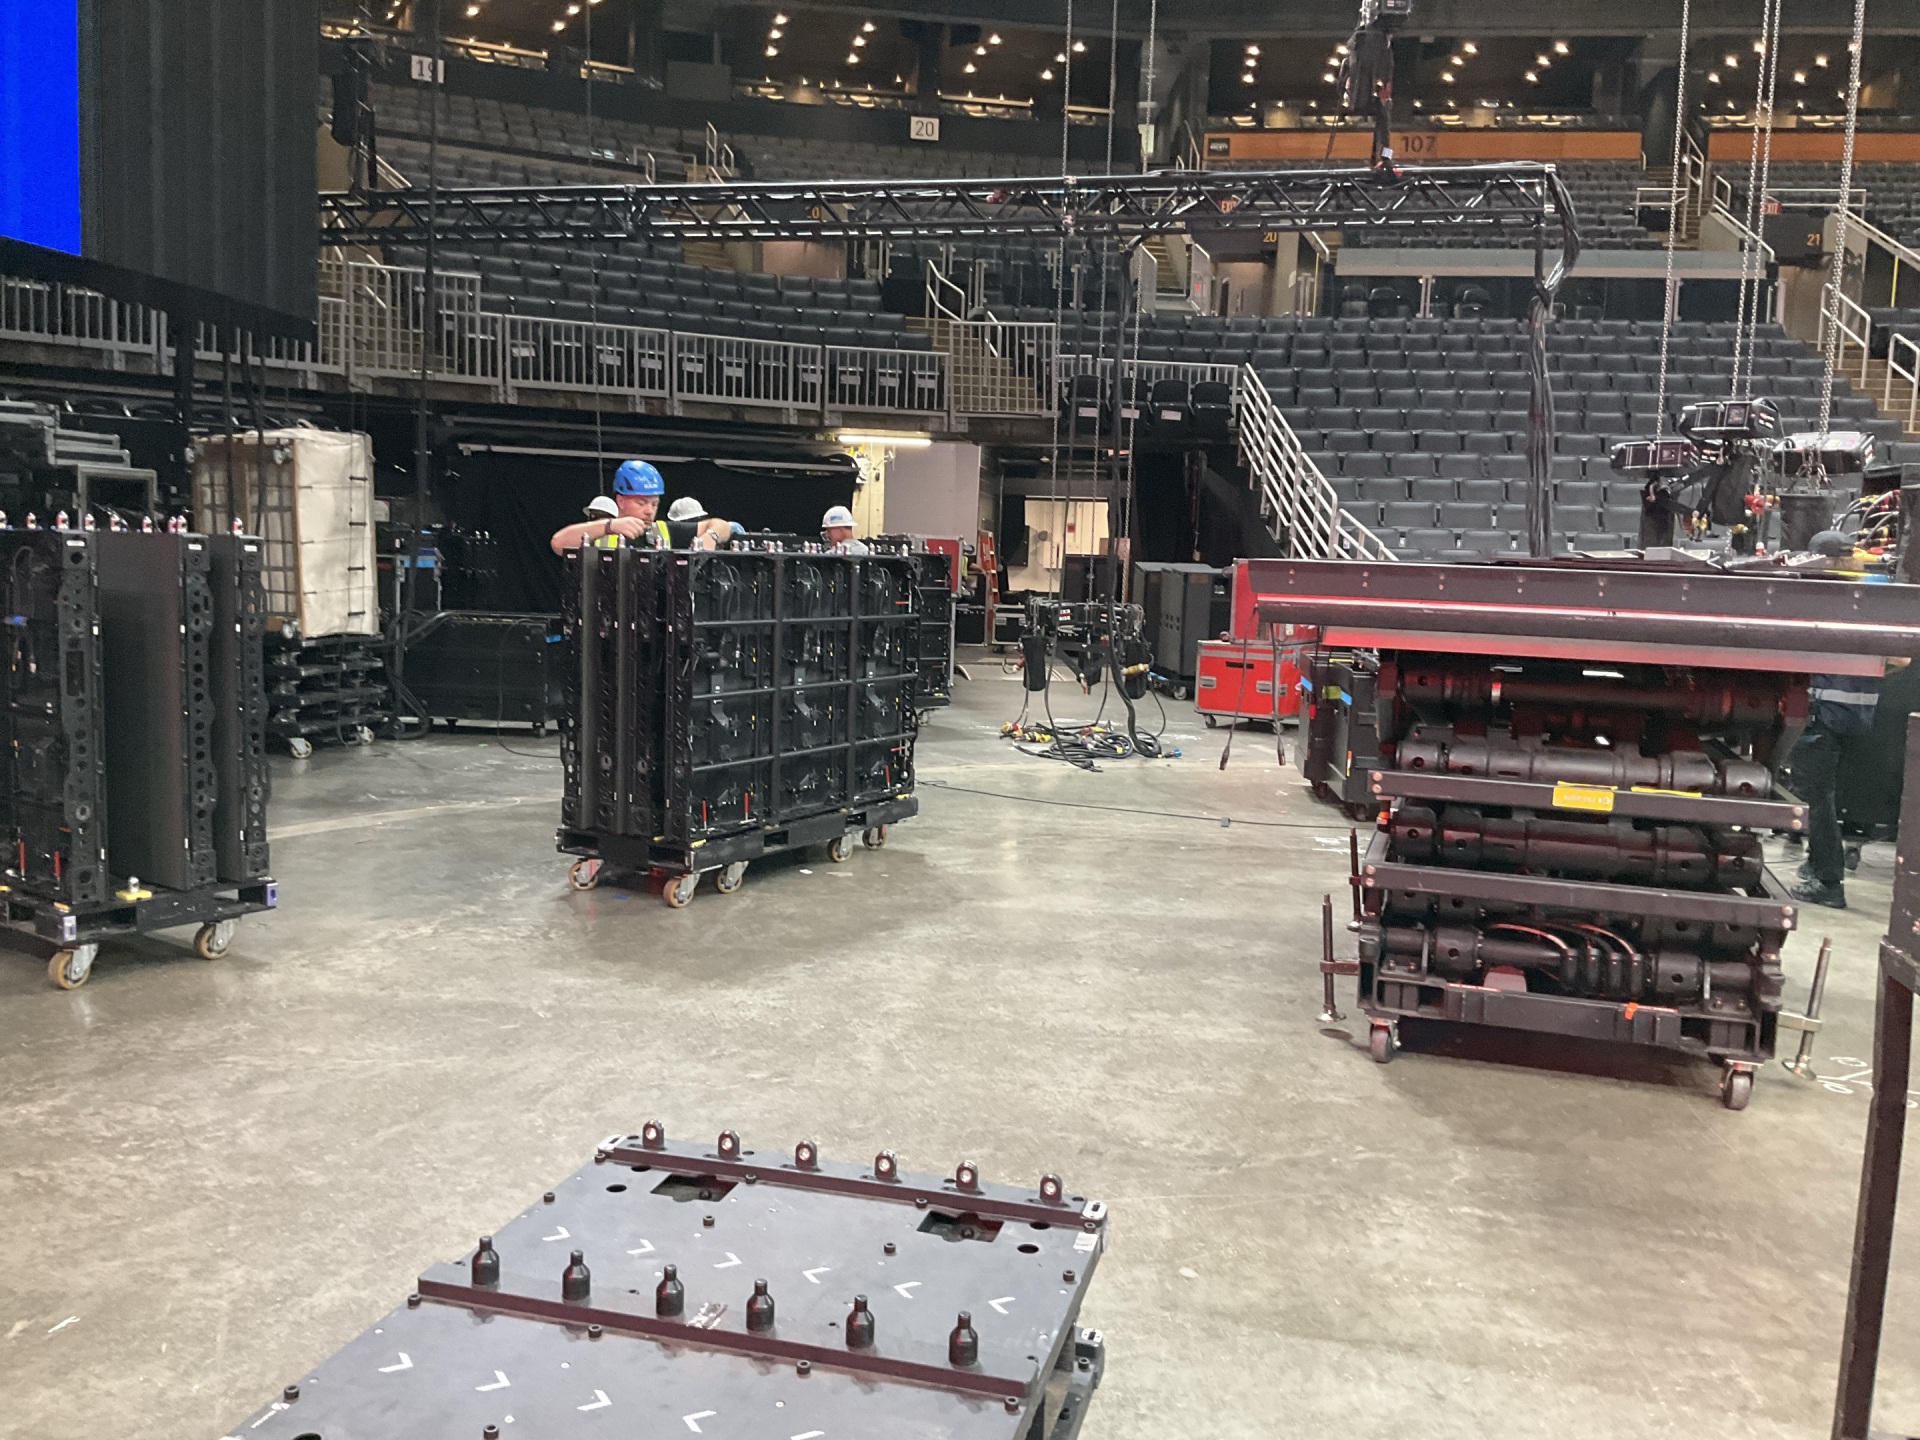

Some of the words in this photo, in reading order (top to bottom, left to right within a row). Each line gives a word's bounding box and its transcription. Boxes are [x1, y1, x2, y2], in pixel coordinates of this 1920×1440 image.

[916, 120, 935, 137] 20
[1402, 135, 1436, 152] 107
[805, 205, 820, 219] 0
[1262, 231, 1277, 243] 20
[1806, 233, 1821, 246] 21
